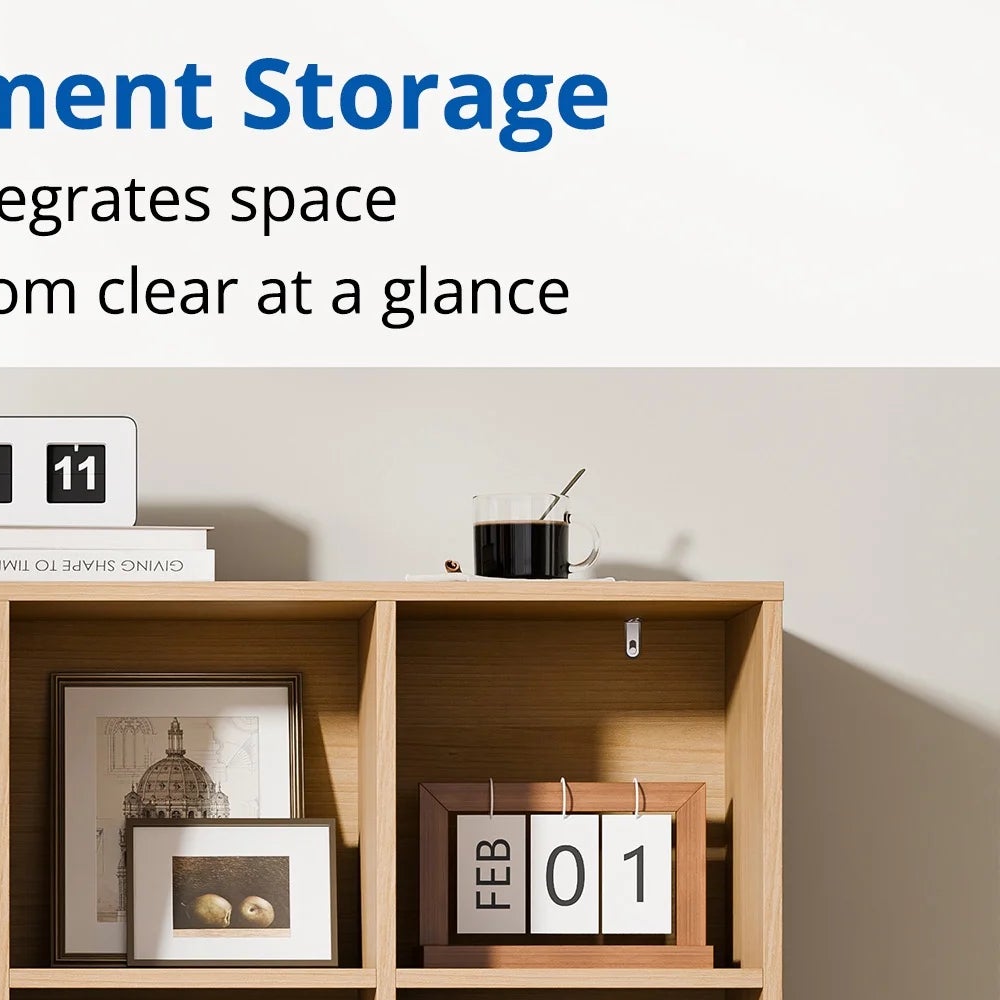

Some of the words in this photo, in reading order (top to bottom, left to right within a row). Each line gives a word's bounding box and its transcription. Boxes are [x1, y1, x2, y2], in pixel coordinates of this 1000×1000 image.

[54, 455, 96, 490] 11
[35, 559, 58, 572] TO
[62, 559, 116, 572] SHAPE
[120, 559, 185, 572] GIVING
[475, 838, 511, 910] FEB
